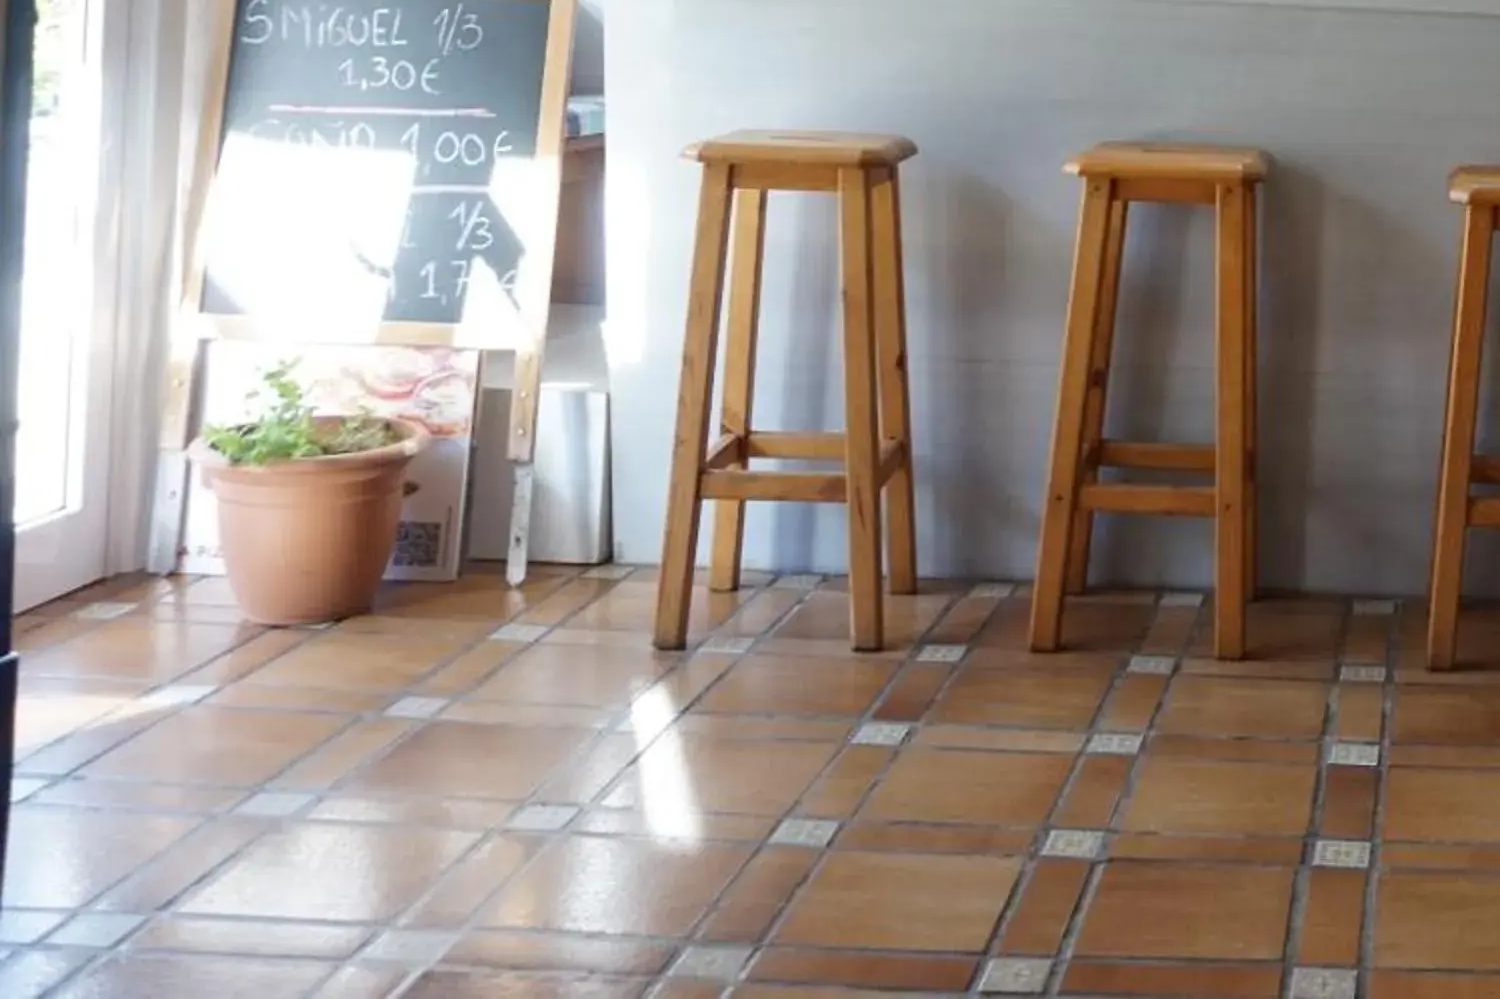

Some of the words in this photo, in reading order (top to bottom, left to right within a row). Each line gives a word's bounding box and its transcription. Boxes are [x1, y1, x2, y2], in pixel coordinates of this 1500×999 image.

[432, 2, 484, 56] 1/3
[337, 55, 443, 95] 1,30€
[448, 200, 495, 252] 1/3
